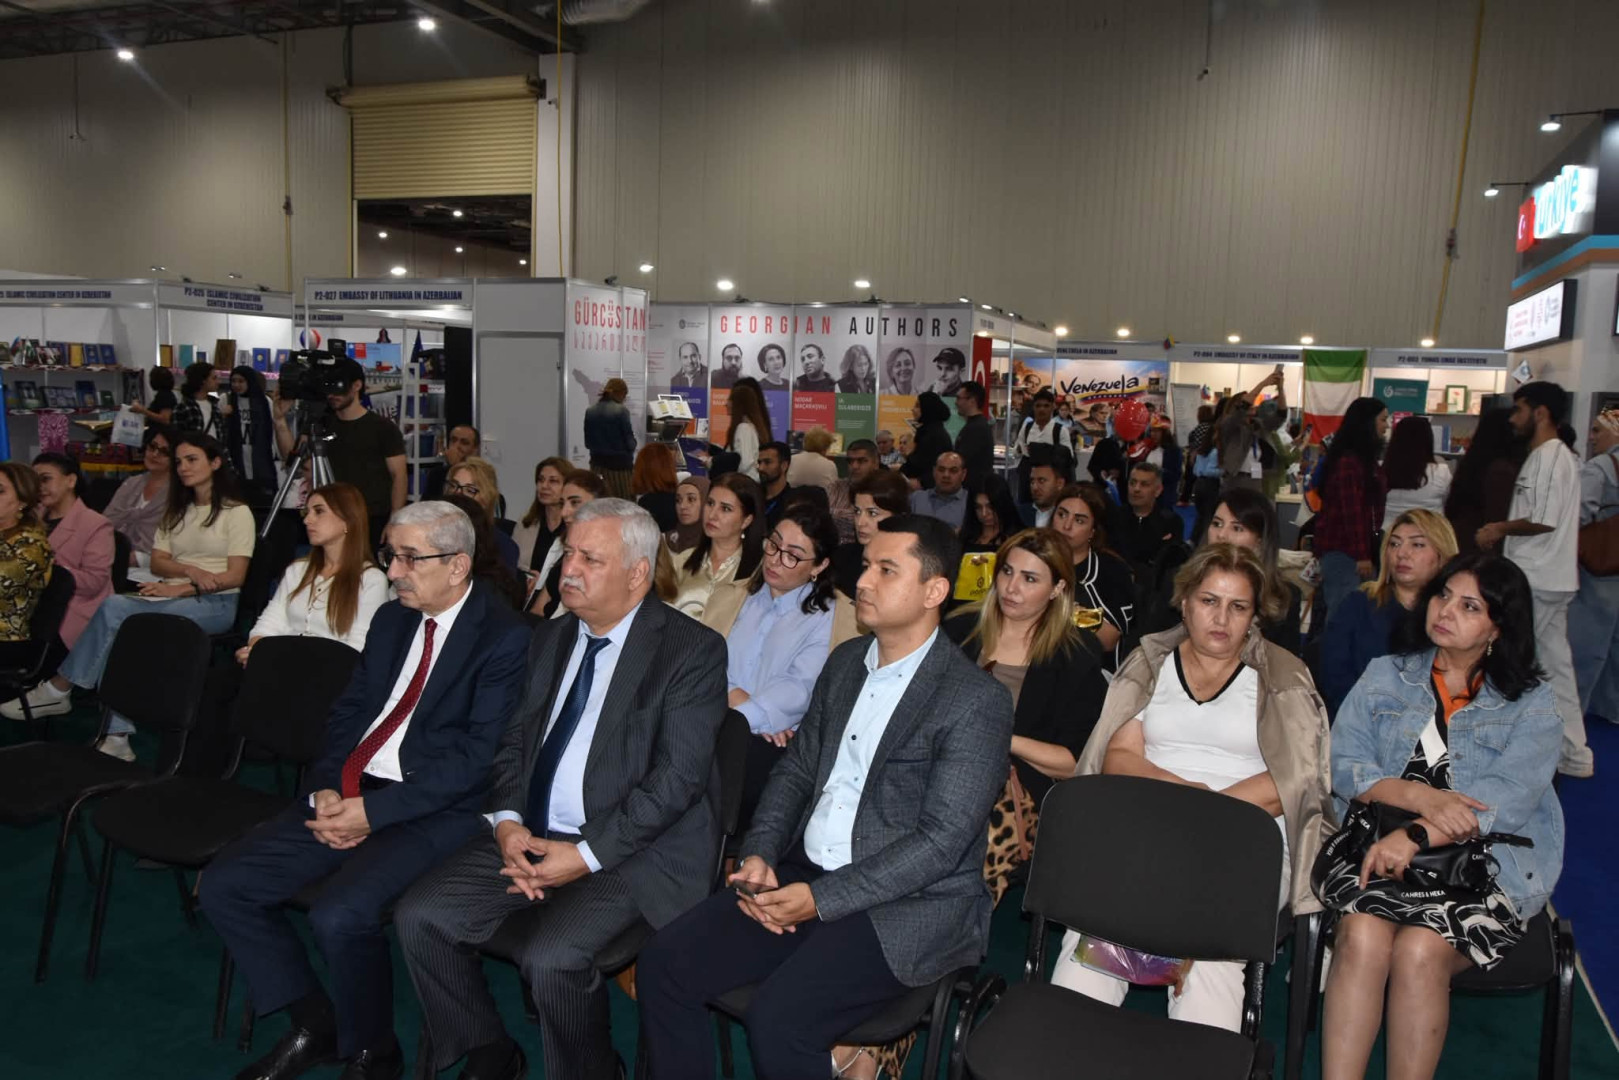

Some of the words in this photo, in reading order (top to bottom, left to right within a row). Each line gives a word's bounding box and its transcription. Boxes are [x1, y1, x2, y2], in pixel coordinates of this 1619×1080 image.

[314, 291, 336, 300] P2-027
[339, 291, 369, 300] EMBASSY
[370, 291, 378, 300] OF
[379, 291, 413, 300] LITHUANIA
[414, 291, 422, 300] IN
[720, 315, 831, 334] GEORGIAN
[849, 316, 957, 337] AUTHORS
